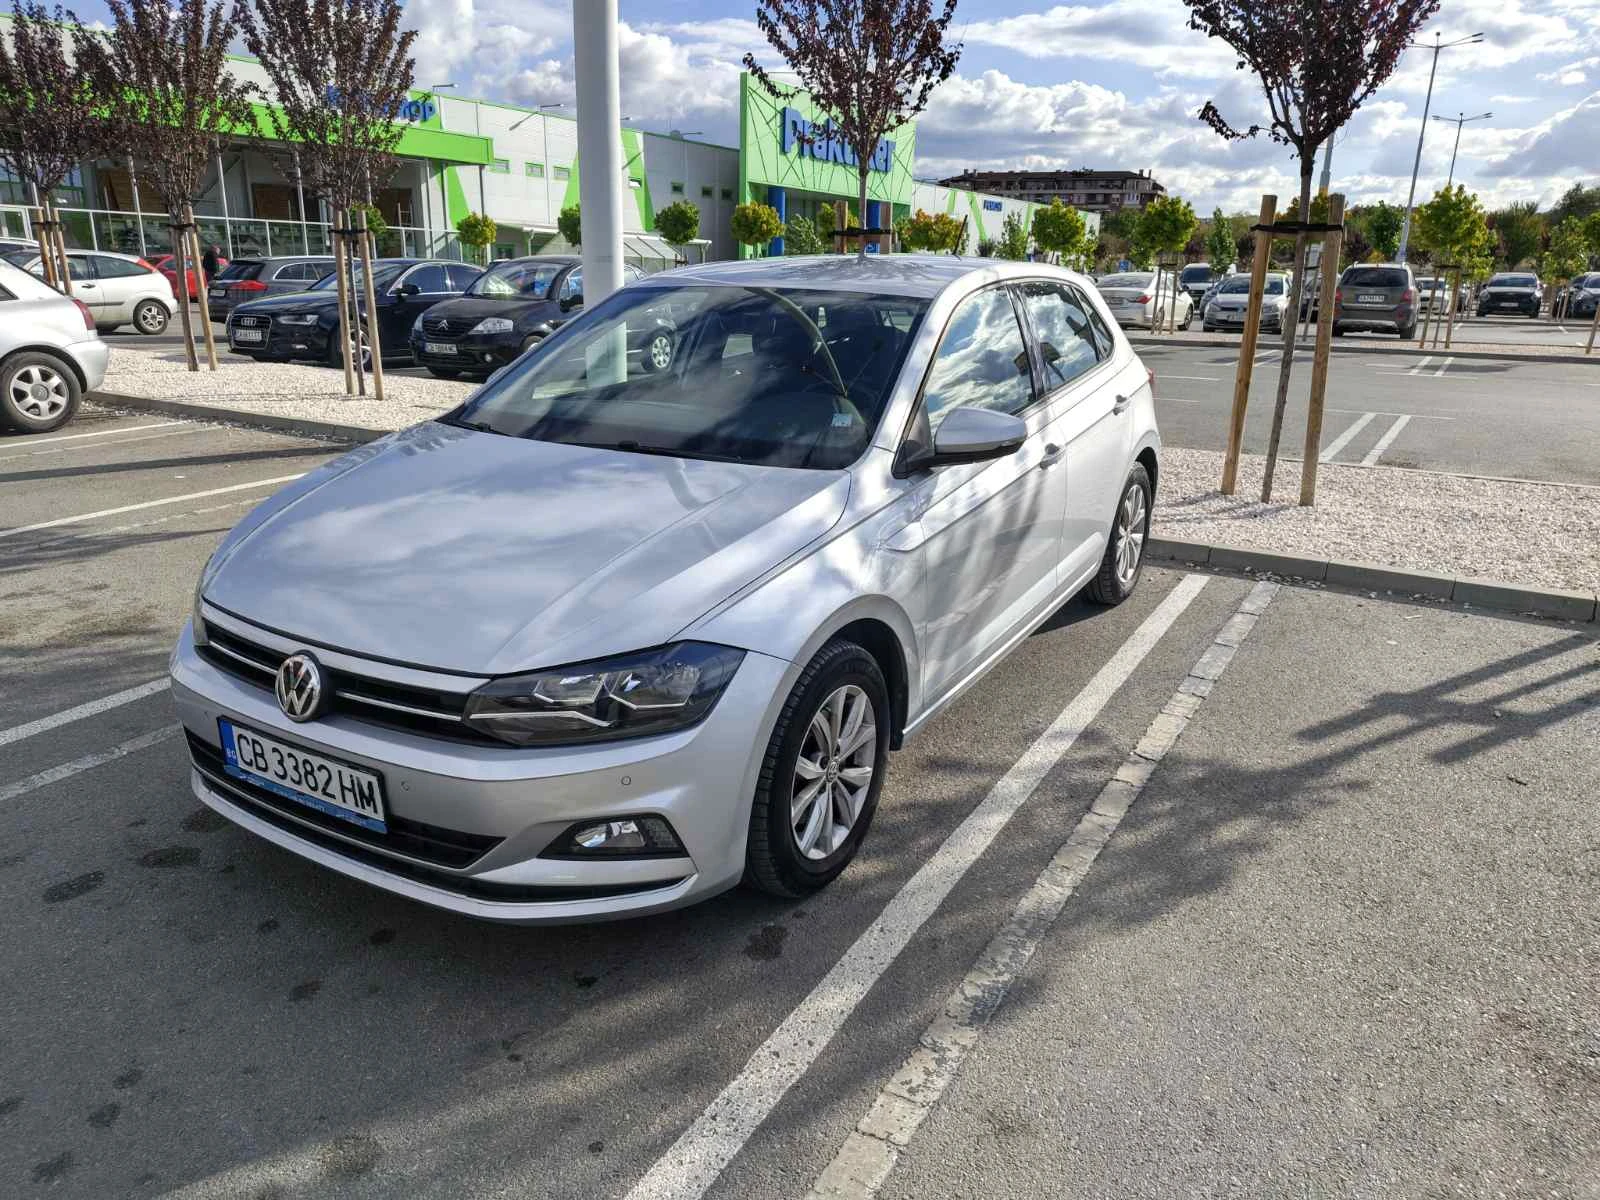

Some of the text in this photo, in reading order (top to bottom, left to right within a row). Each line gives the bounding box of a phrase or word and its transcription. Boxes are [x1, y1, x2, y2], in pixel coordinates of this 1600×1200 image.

[237, 733, 379, 814] CB 3382 HM
